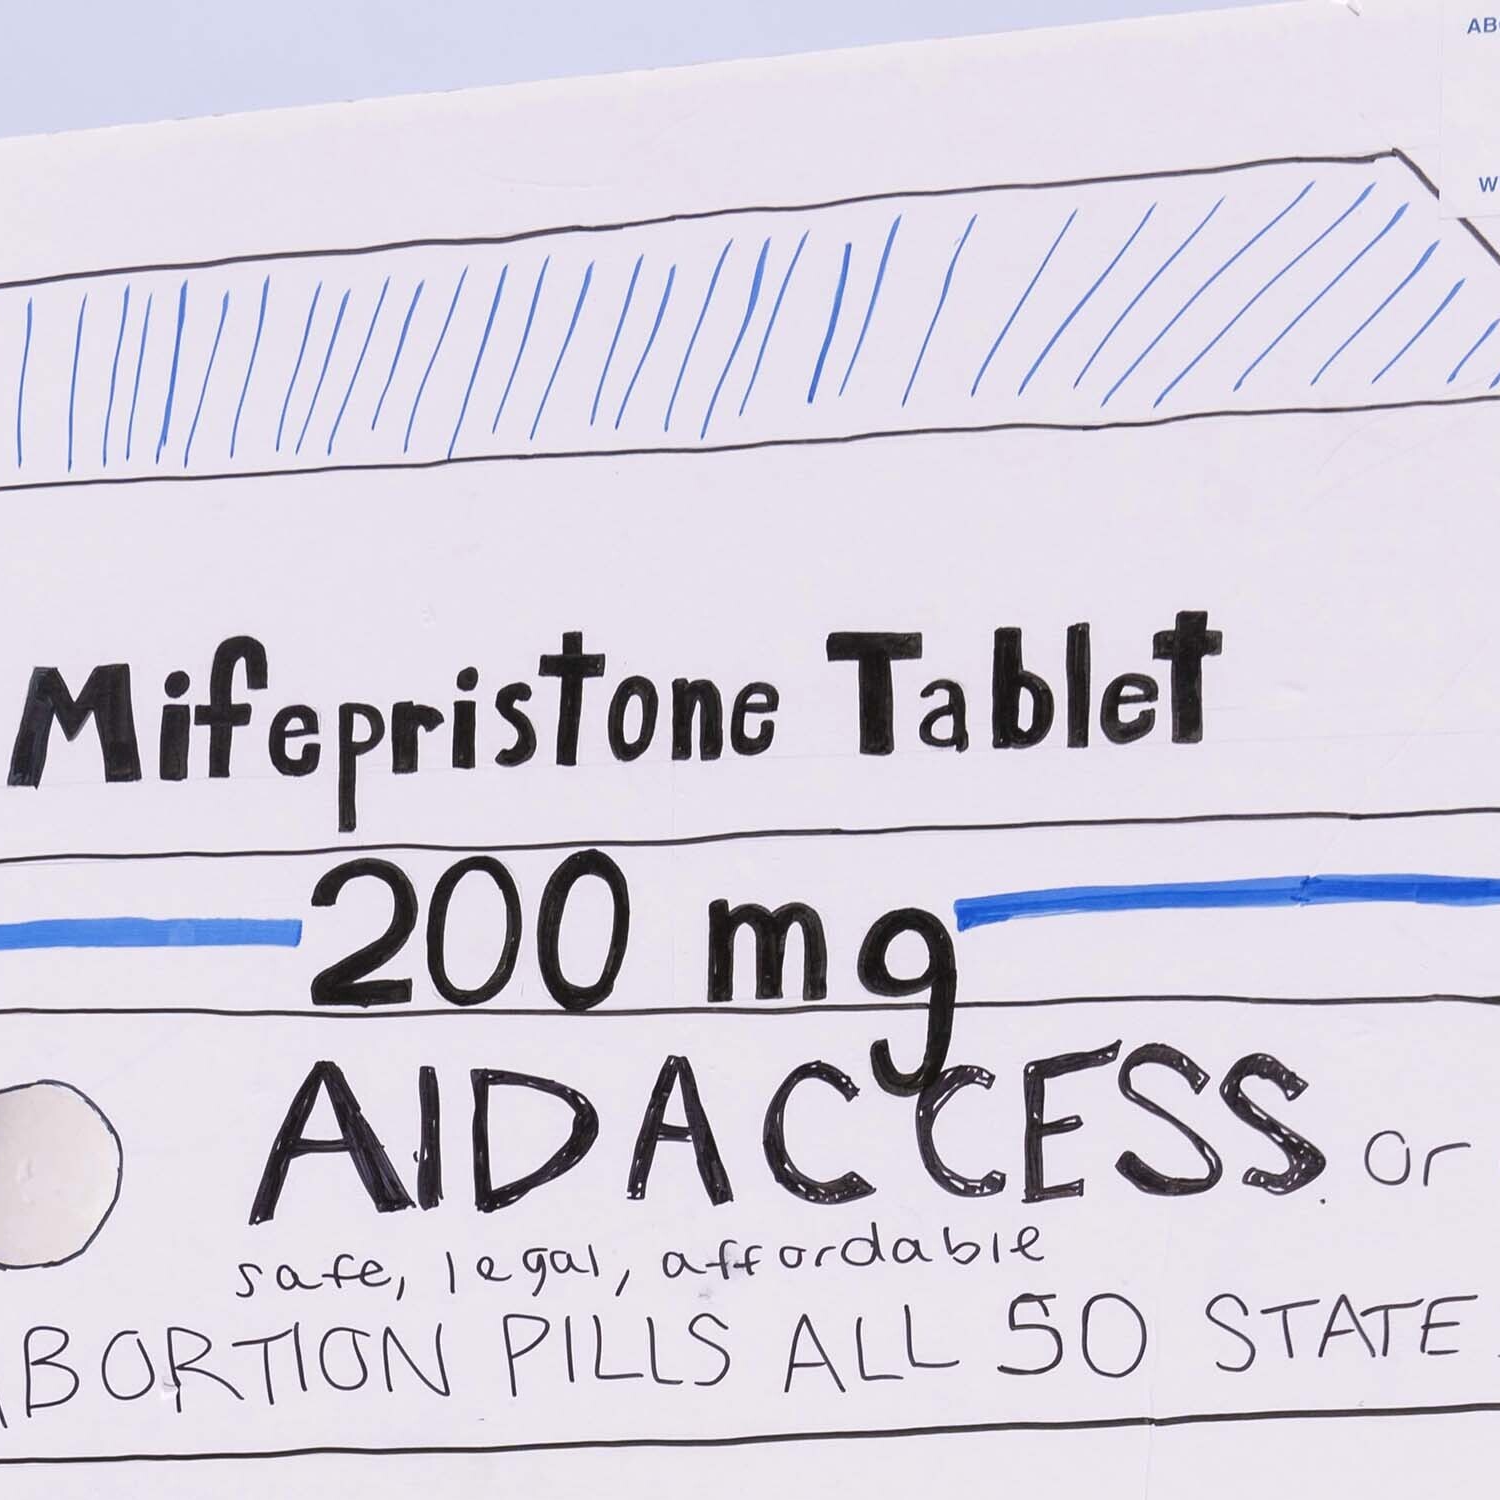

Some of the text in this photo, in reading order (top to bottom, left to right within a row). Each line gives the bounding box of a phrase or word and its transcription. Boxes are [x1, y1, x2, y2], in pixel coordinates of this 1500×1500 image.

[7, 609, 1226, 834] Mifepristone Tablet
[307, 847, 960, 1098] 200 mg
[234, 1220, 1048, 1303] safe, legal, affordable
[501, 1309, 735, 1399] PILLS
[783, 1300, 962, 1394] ALL
[994, 1290, 1150, 1380] 50
